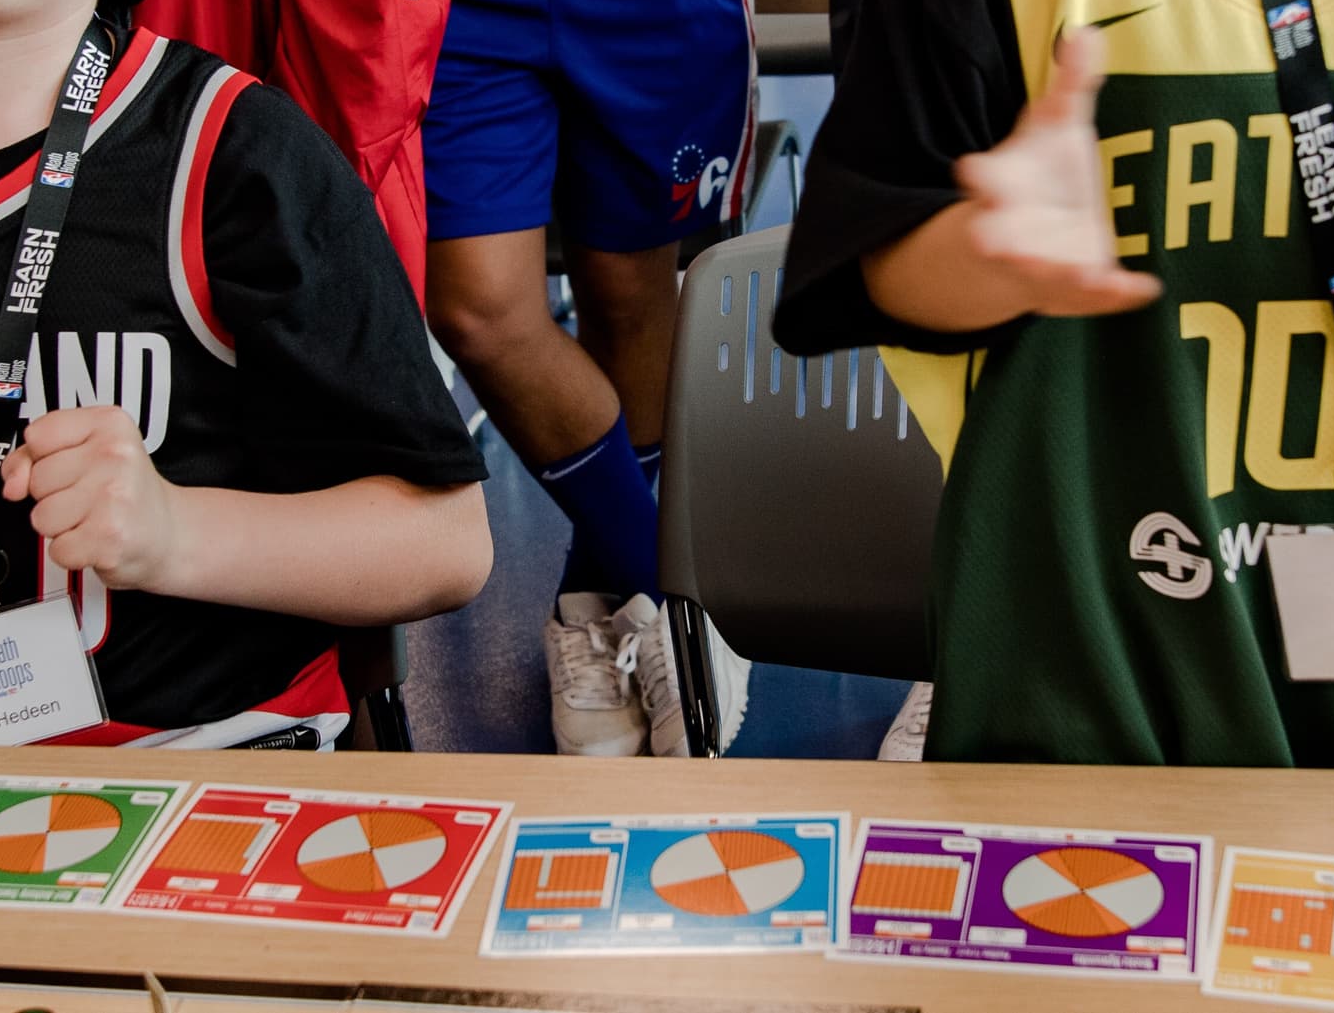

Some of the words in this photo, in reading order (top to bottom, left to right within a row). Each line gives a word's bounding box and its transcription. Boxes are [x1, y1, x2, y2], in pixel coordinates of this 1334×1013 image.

[61, 40, 98, 111] LEARN
[78, 50, 111, 114] FRESH
[1289, 109, 1332, 224] FRESH
[7, 227, 43, 313] LEARN
[23, 230, 60, 314] FRESH
[9, 360, 26, 383] Hoops
